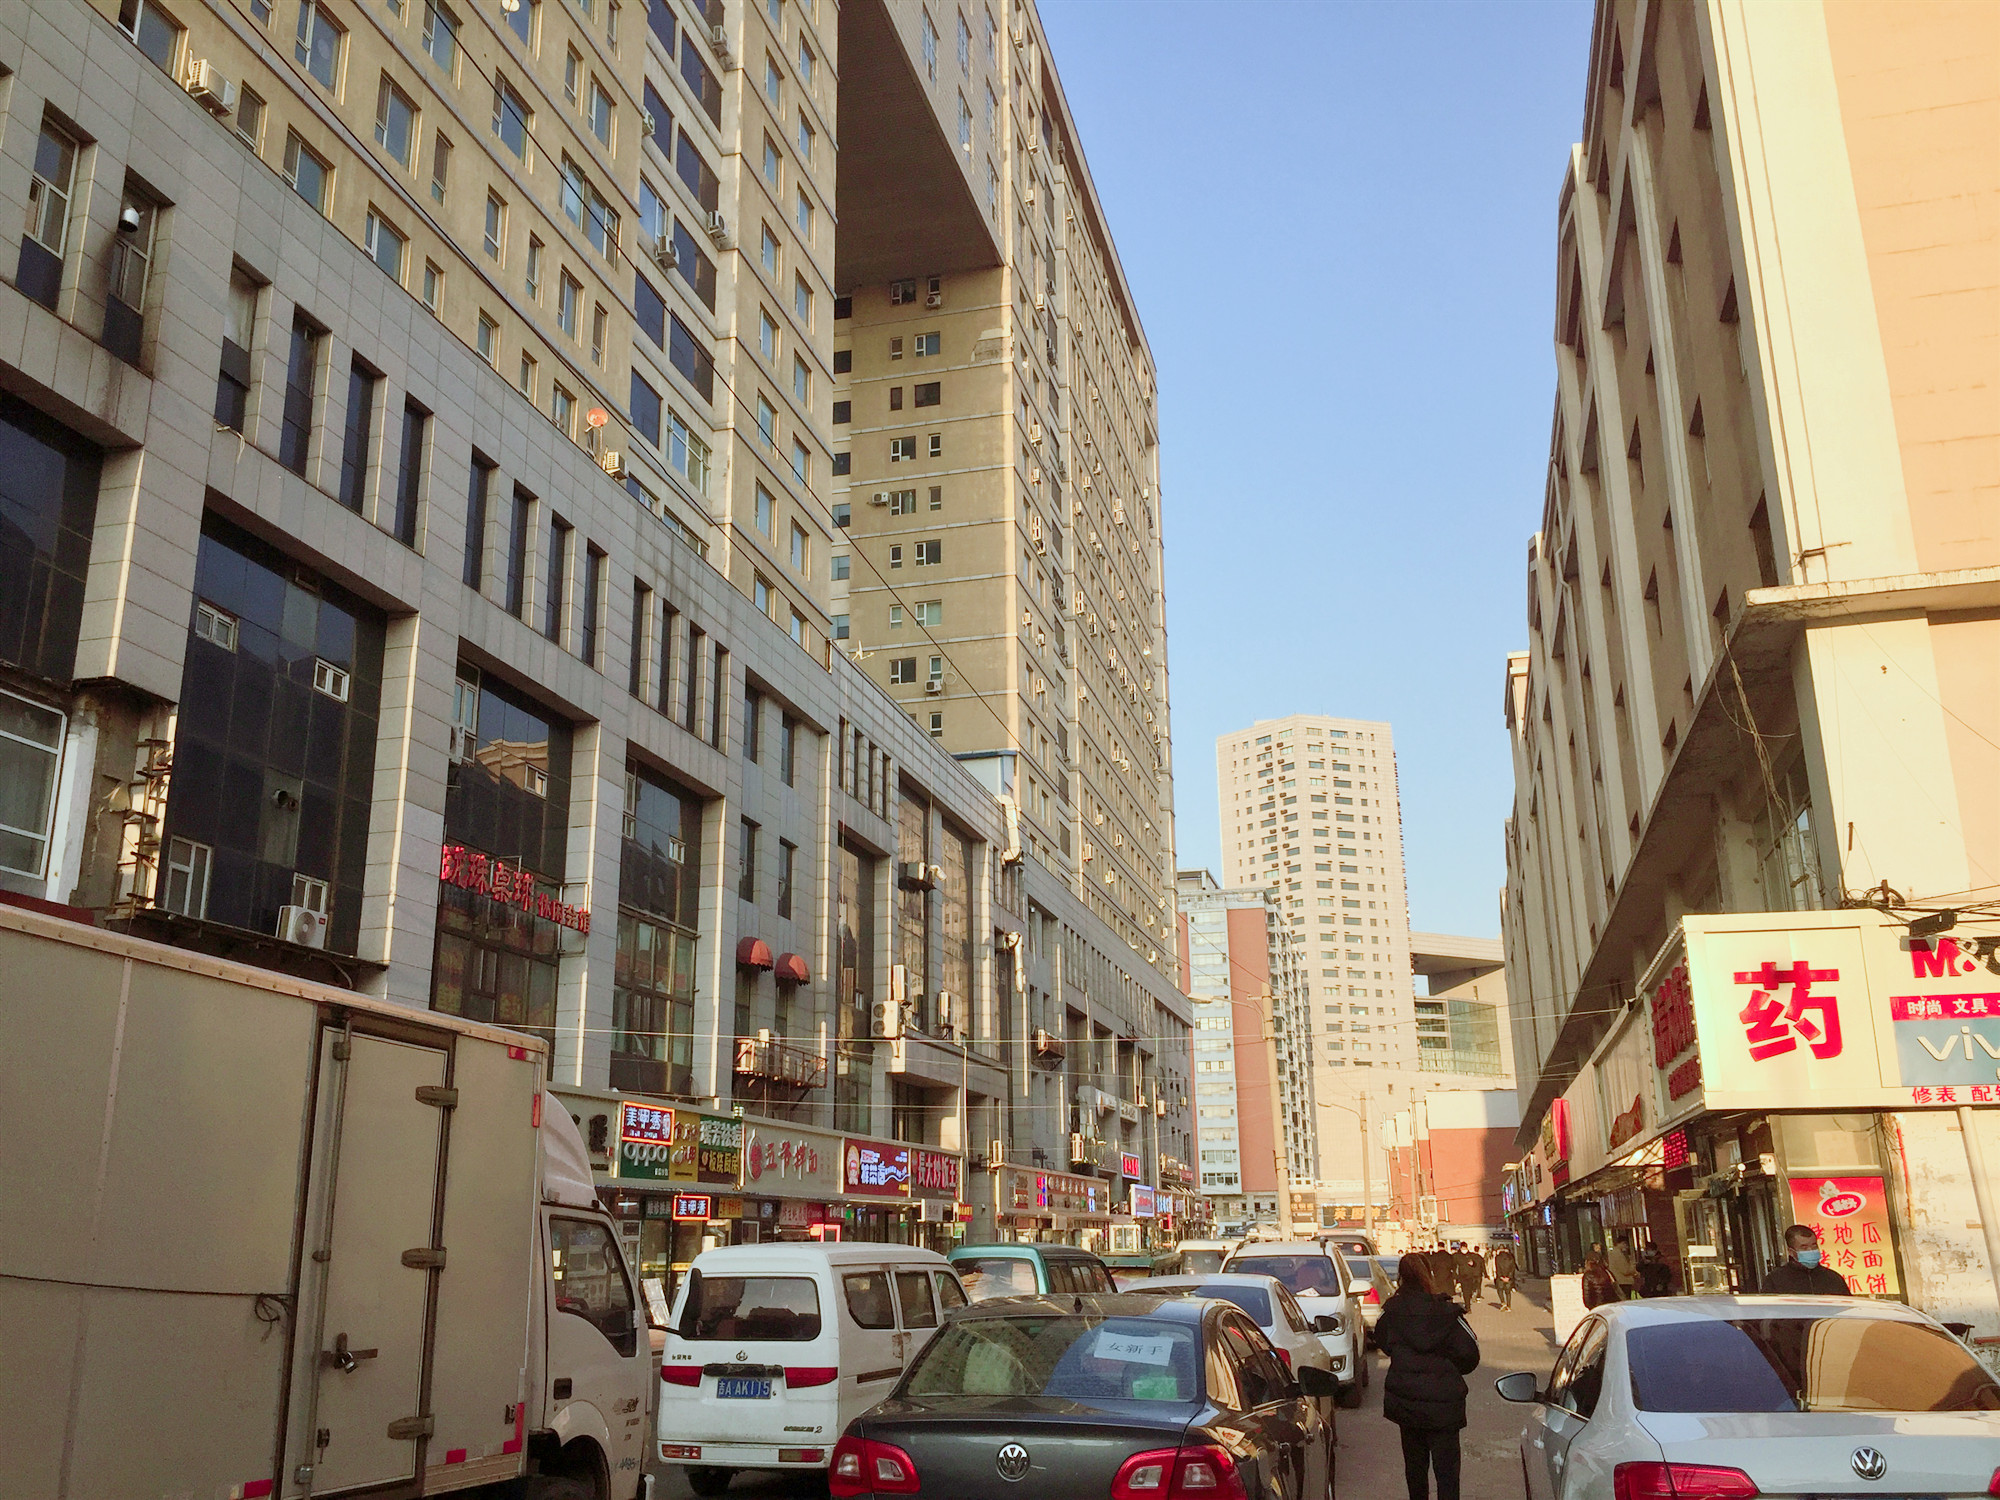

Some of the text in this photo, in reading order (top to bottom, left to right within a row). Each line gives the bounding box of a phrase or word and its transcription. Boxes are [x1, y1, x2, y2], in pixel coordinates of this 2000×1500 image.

[1733, 961, 1843, 1062] 药
[1907, 998, 1988, 1016] 时尚 文具
[1912, 1085, 2000, 1104] 修表 配
[626, 1107, 661, 1131] 美甲秀
[678, 1199, 706, 1216] 美甲秀
[1107, 1342, 1163, 1355] 女新手
